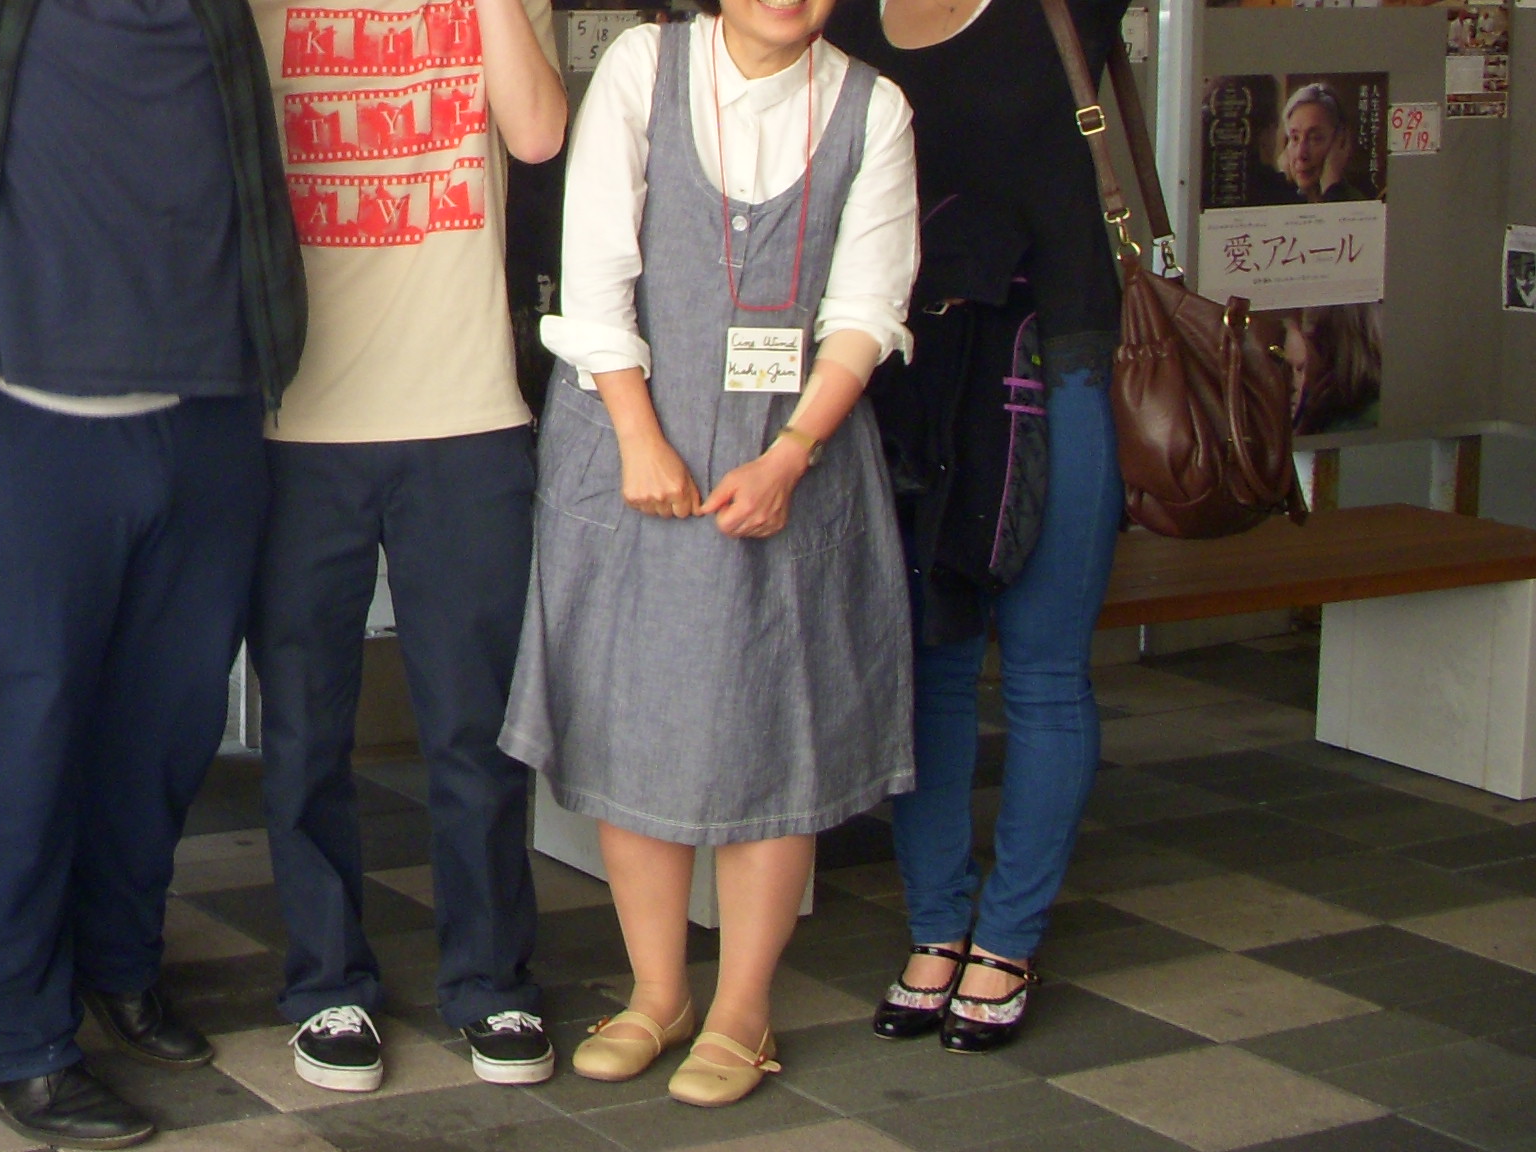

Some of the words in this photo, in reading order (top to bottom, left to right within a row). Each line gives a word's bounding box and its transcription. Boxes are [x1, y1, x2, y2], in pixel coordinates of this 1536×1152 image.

[1392, 108, 1404, 129] 6
[1223, 233, 1365, 275] 愛、アムール
